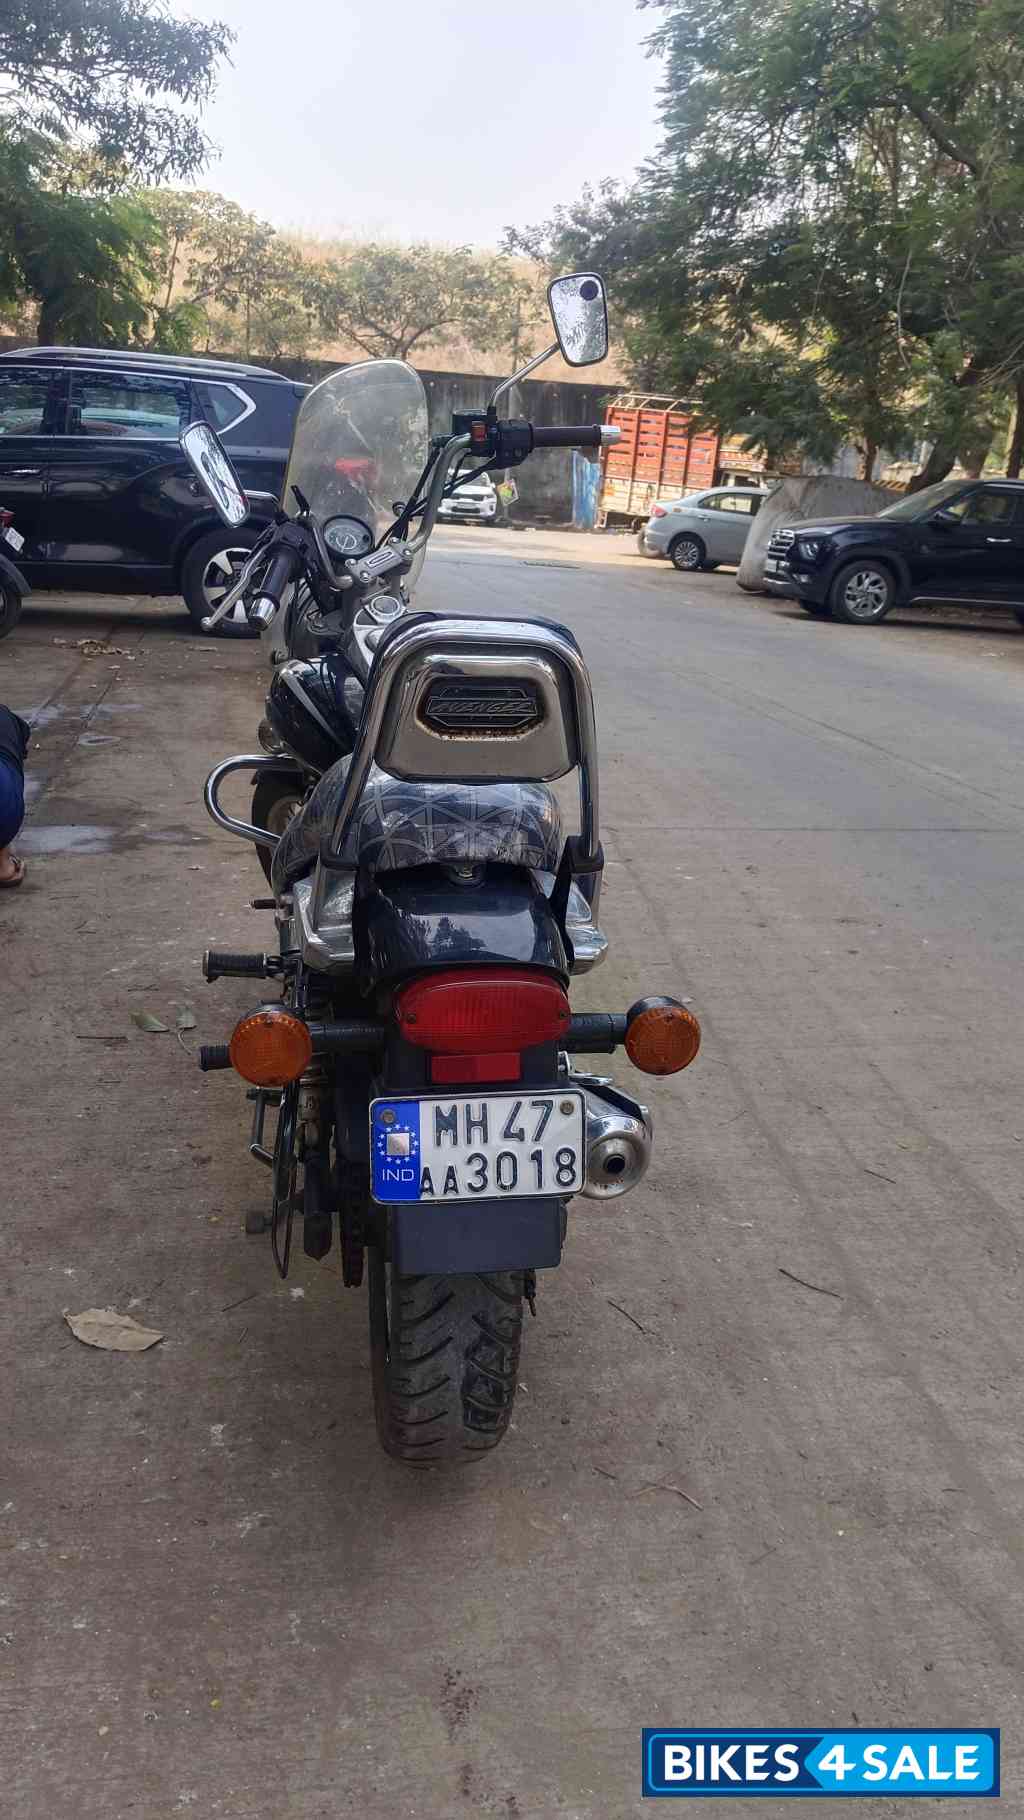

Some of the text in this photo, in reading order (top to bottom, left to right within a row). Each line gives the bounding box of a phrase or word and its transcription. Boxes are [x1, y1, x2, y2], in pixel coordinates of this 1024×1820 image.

[435, 1099, 554, 1147] MH 47
[381, 1168, 415, 1182] IND
